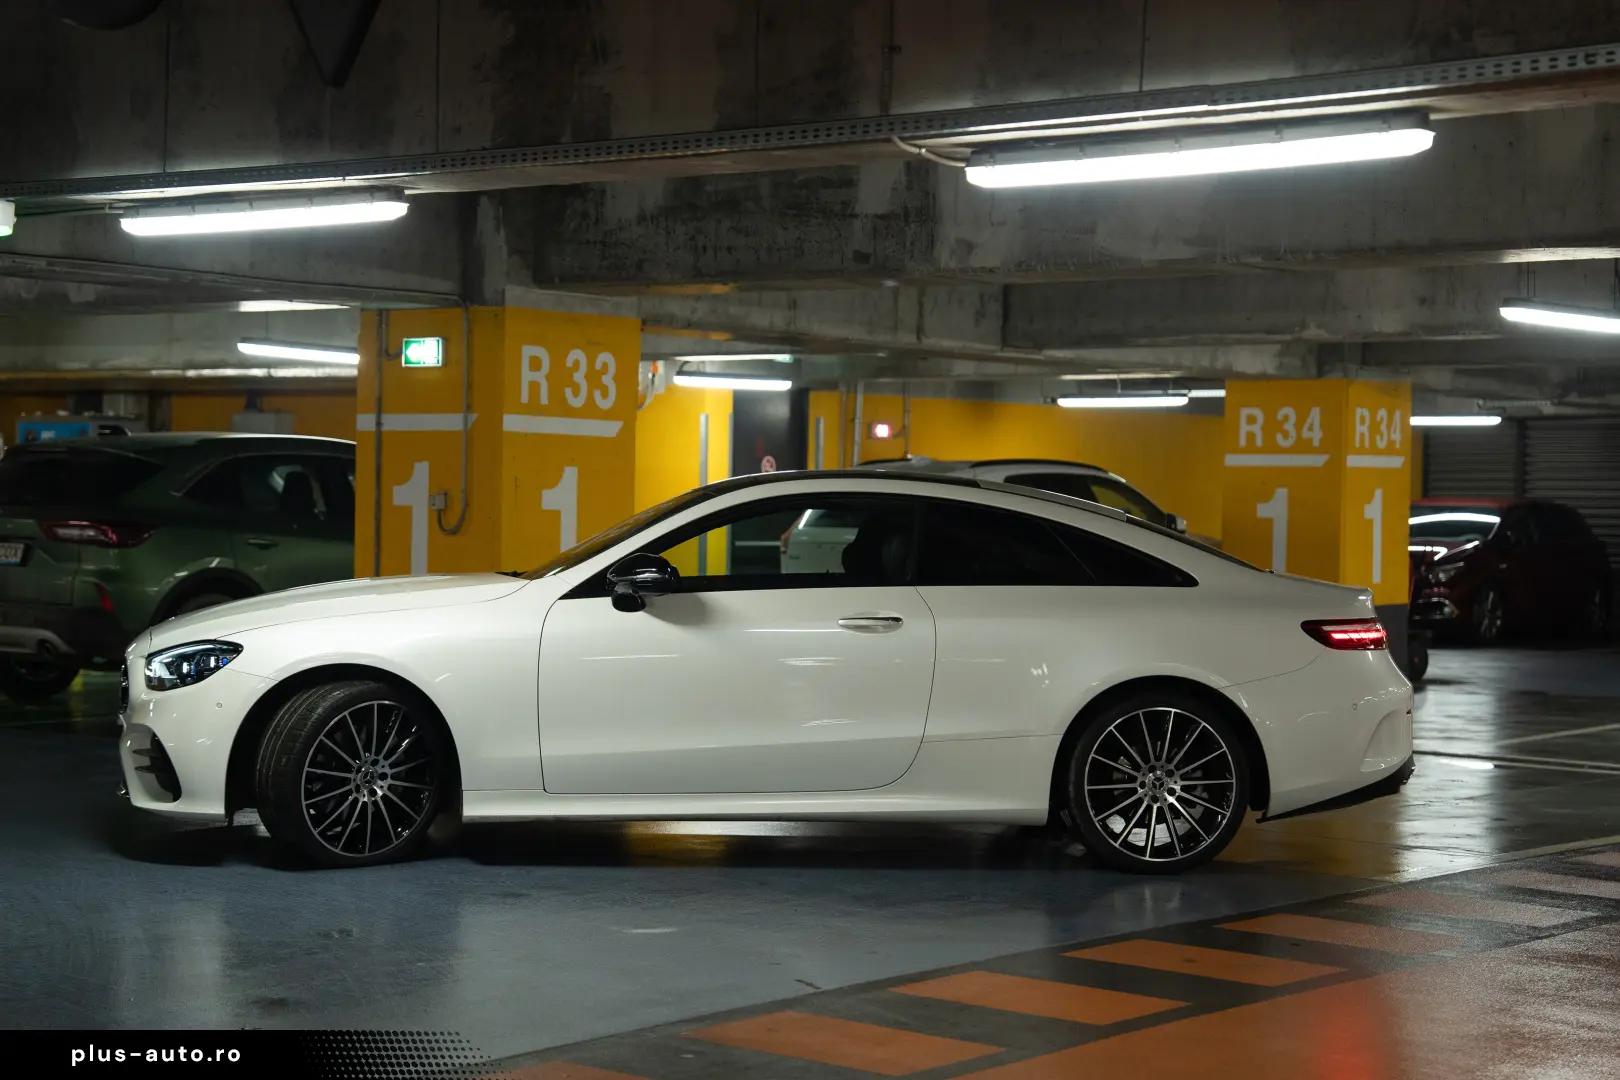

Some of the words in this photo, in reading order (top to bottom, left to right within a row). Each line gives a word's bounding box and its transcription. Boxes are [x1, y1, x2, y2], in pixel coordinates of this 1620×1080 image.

[520, 345, 550, 405] R
[564, 349, 617, 410] 33
[1239, 406, 1265, 448] R
[1275, 406, 1323, 448] 34
[1355, 406, 1370, 448] R
[1376, 408, 1402, 449] 34
[393, 461, 429, 576] 1
[541, 466, 578, 552] 1
[1256, 487, 1288, 573] 1
[1364, 488, 1383, 584] 1
